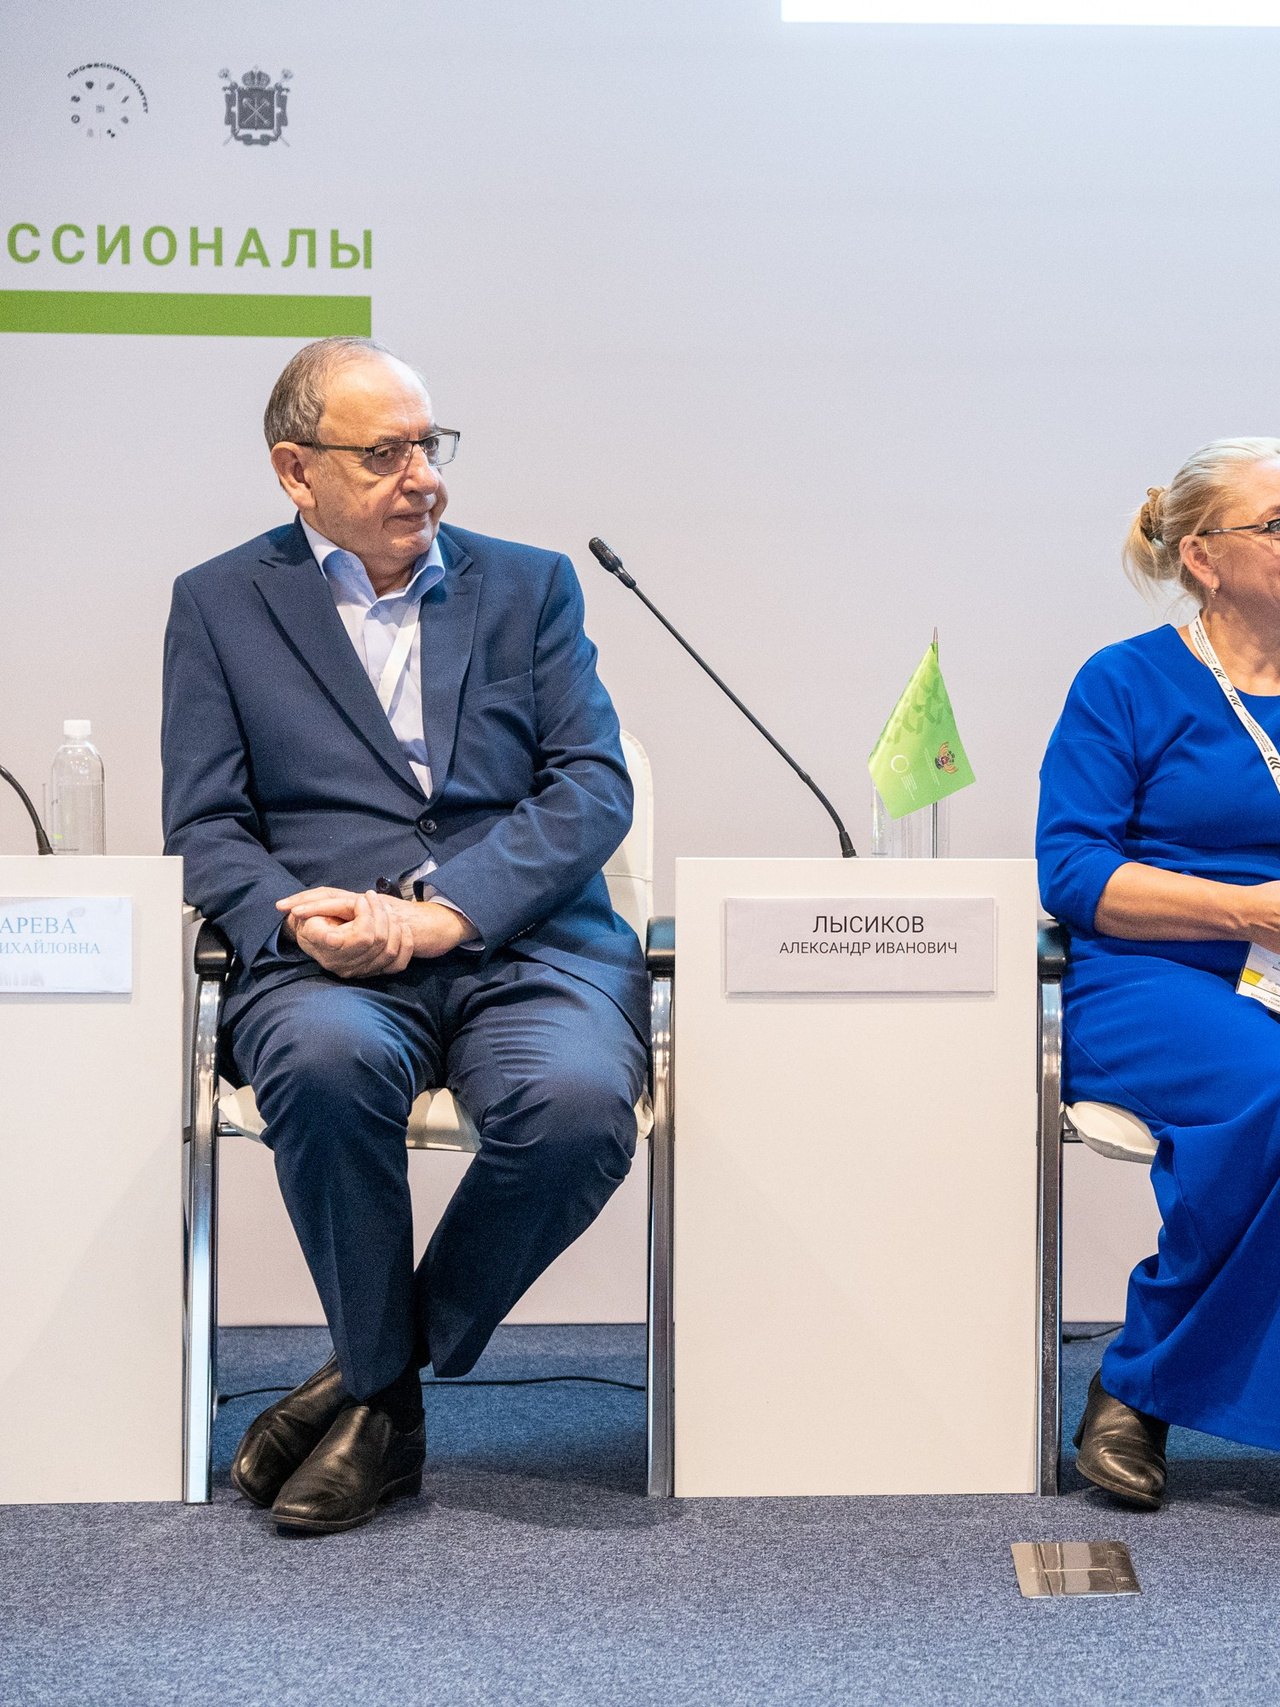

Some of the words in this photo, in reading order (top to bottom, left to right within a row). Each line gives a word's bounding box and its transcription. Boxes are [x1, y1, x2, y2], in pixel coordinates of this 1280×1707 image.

[7, 222, 372, 269] ССИОНАЛЫ
[0, 917, 76, 934] АРЕВА
[812, 916, 925, 933] ЛЫСИКОВ
[0, 939, 101, 954] ИХАЙЛОВНА
[779, 941, 871, 956] АЛЕКСАНДР
[875, 941, 957, 954] ИВАНОВИЧ
